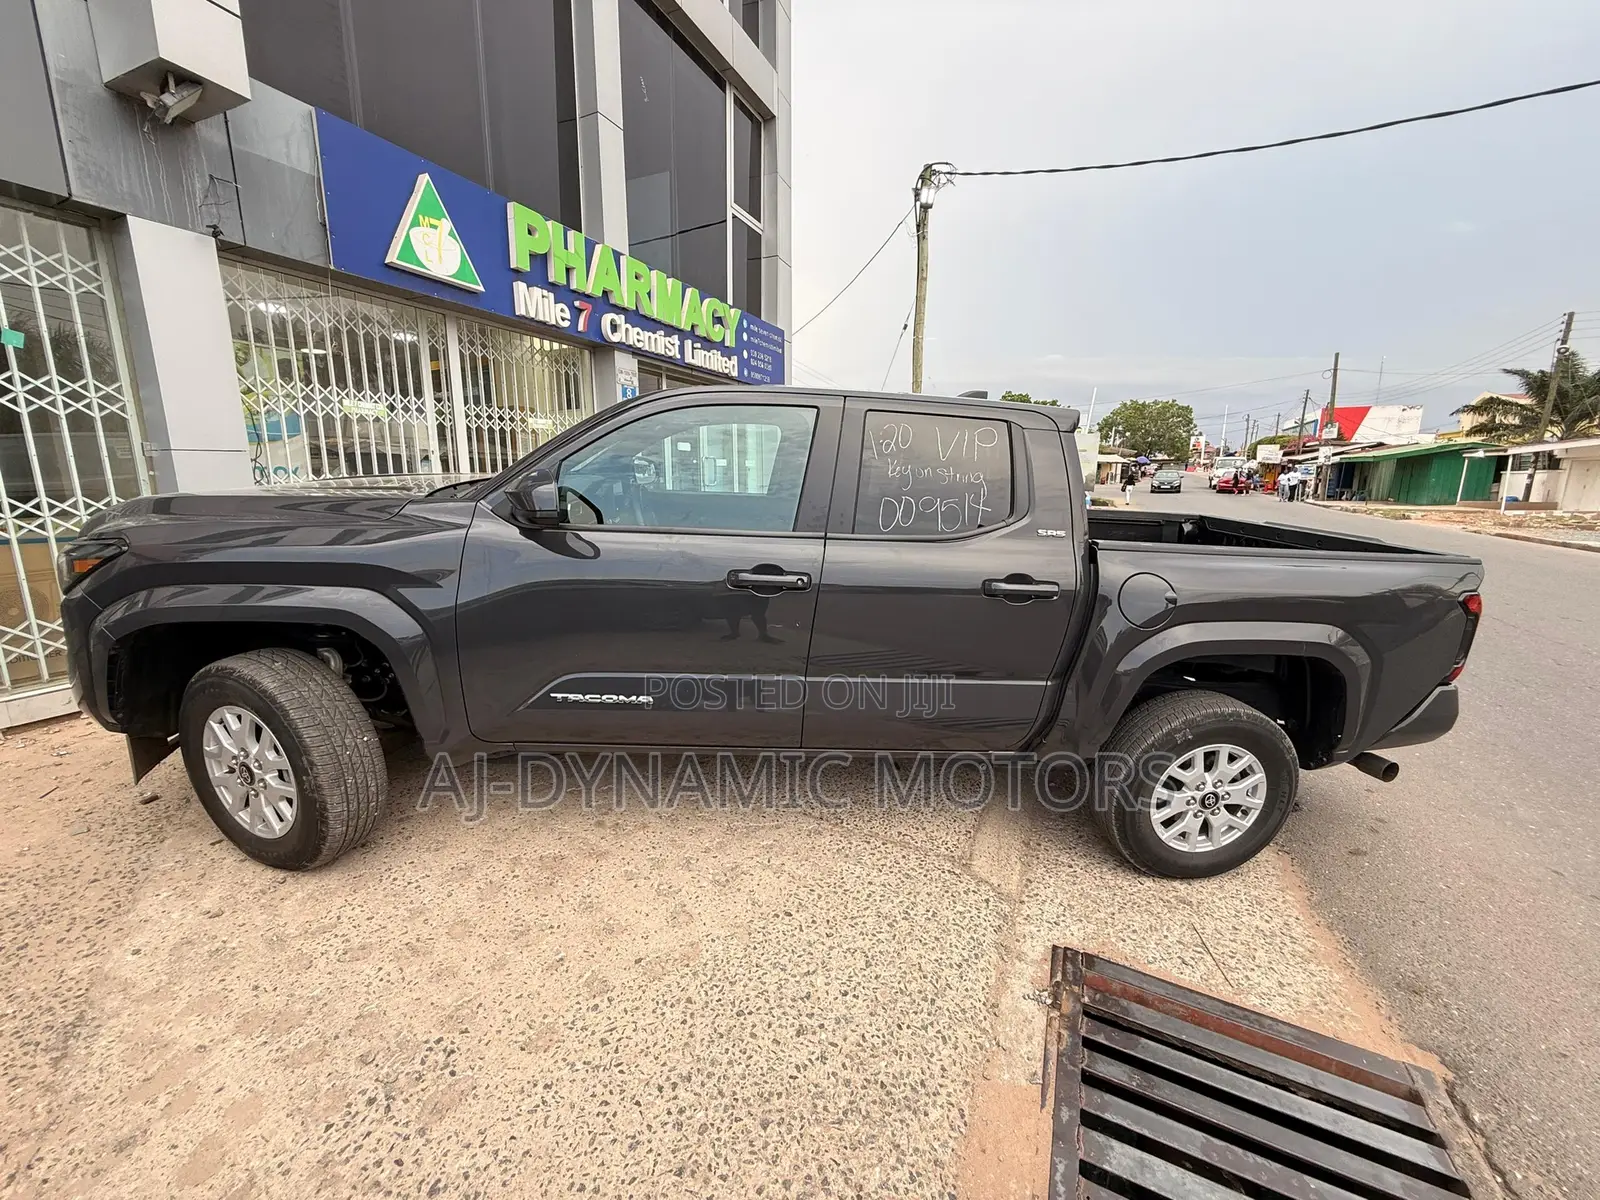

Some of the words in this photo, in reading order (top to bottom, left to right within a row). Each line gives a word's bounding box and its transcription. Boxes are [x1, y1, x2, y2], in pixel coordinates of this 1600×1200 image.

[507, 201, 741, 347] PHARMACY
[512, 281, 571, 328] Mile
[573, 300, 593, 332] 7
[600, 312, 681, 360] Chemist
[684, 338, 739, 377] Limited
[935, 426, 998, 462] VIP
[915, 465, 932, 478] on
[1036, 528, 1067, 539] SR5
[549, 693, 654, 705] TACOMA
